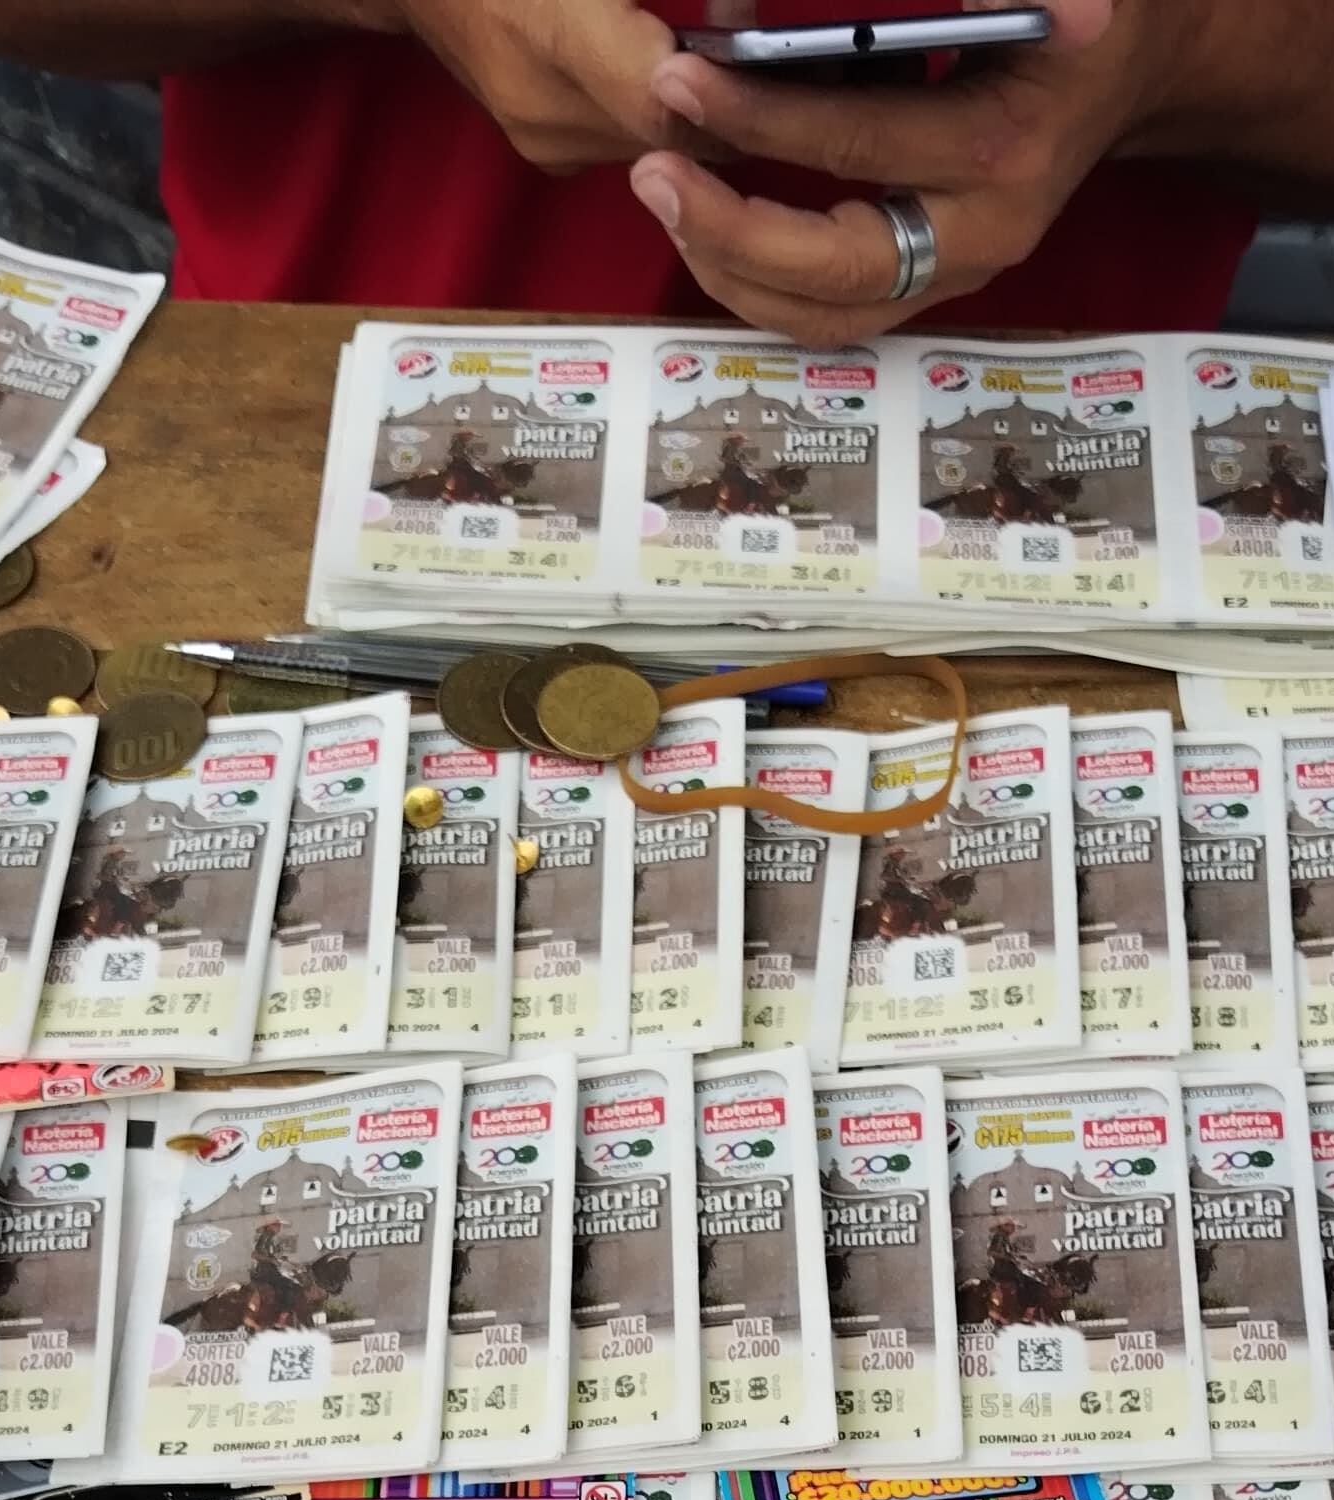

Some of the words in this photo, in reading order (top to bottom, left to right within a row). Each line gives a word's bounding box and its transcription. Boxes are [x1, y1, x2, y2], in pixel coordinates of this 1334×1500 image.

[329, 1200, 425, 1233] patria
[1066, 1204, 1164, 1239] patria
[314, 1226, 421, 1250] voluntad
[1052, 1230, 1163, 1253] voluntad
[735, 1319, 771, 1337] VALE
[363, 1334, 399, 1353] VALE
[1118, 1334, 1153, 1351] VALE
[187, 1343, 245, 1362] SORTEO
[979, 1432, 1039, 1445] DOMINGO
[1042, 1432, 1057, 1443] 21
[1061, 1431, 1097, 1442] JULIO
[1100, 1429, 1132, 1441] 2024
